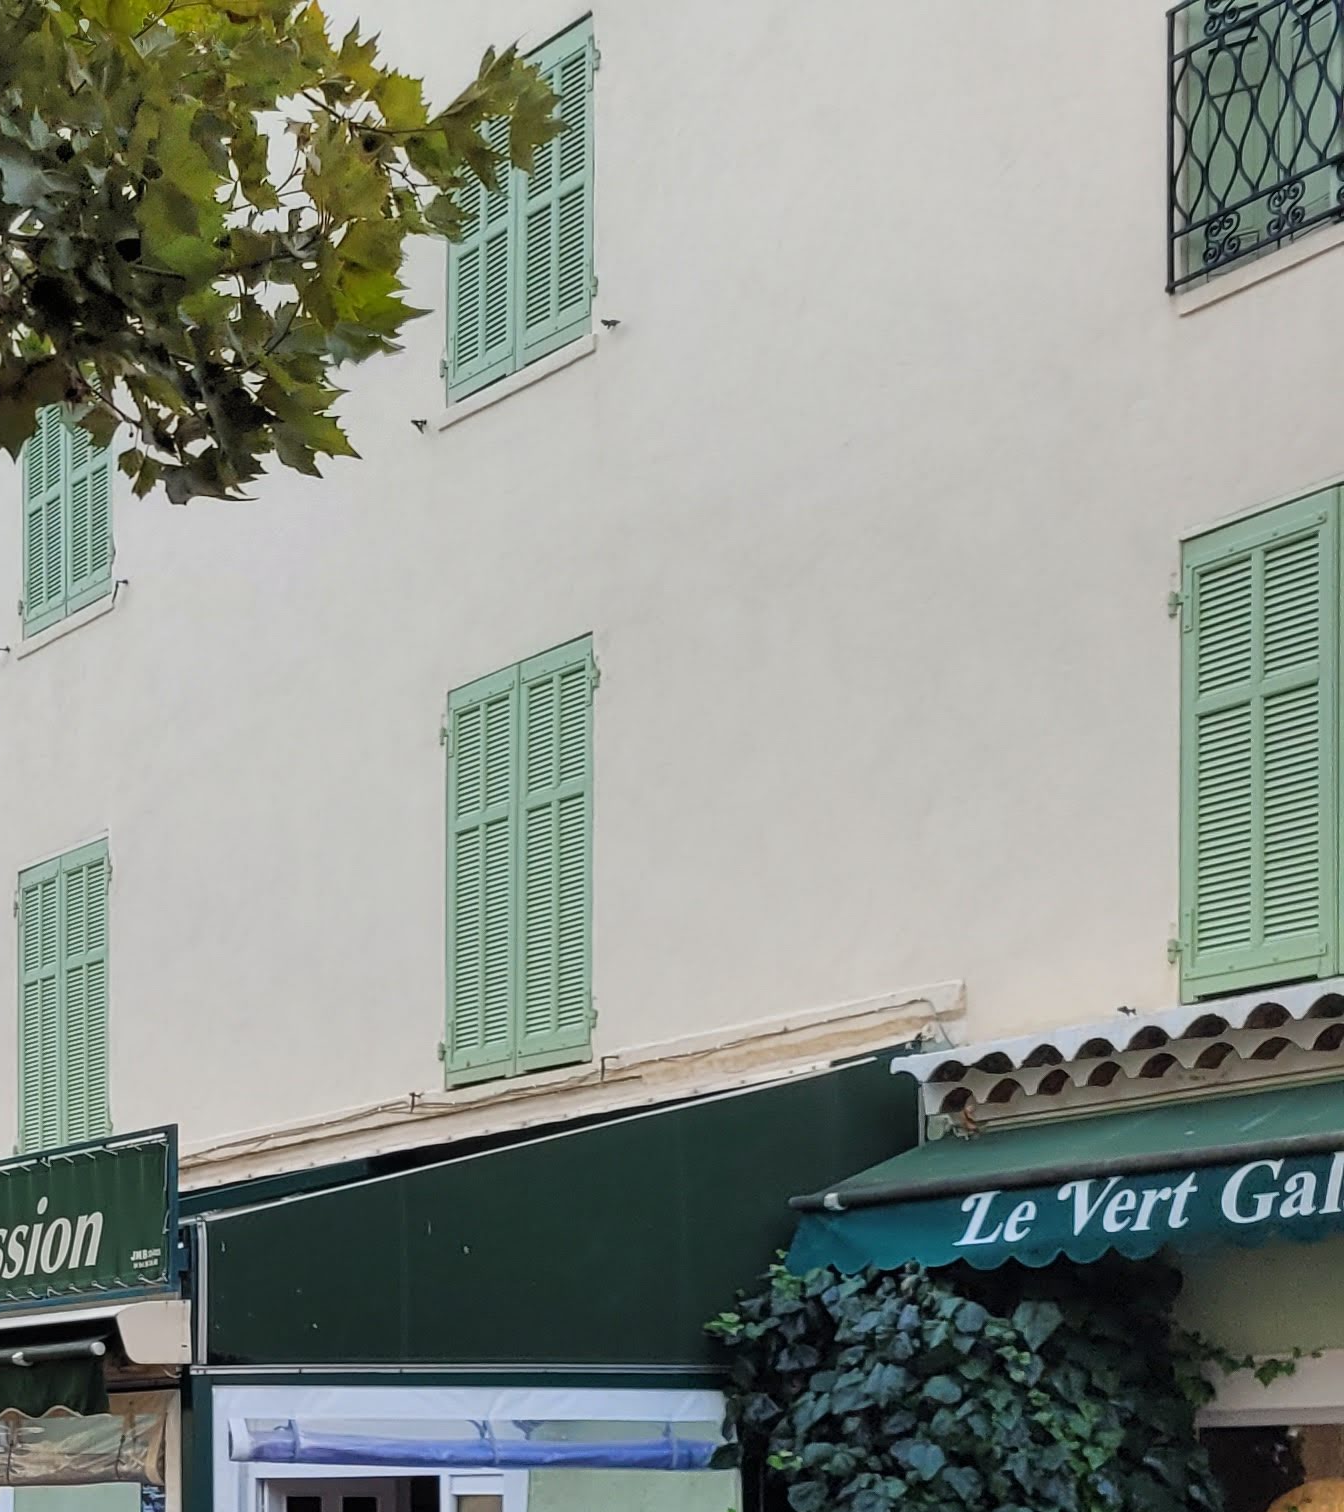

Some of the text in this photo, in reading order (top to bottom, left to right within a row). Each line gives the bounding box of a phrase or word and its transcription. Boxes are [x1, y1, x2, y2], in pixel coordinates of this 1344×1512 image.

[952, 1150, 1344, 1247] Le Vert Gal
